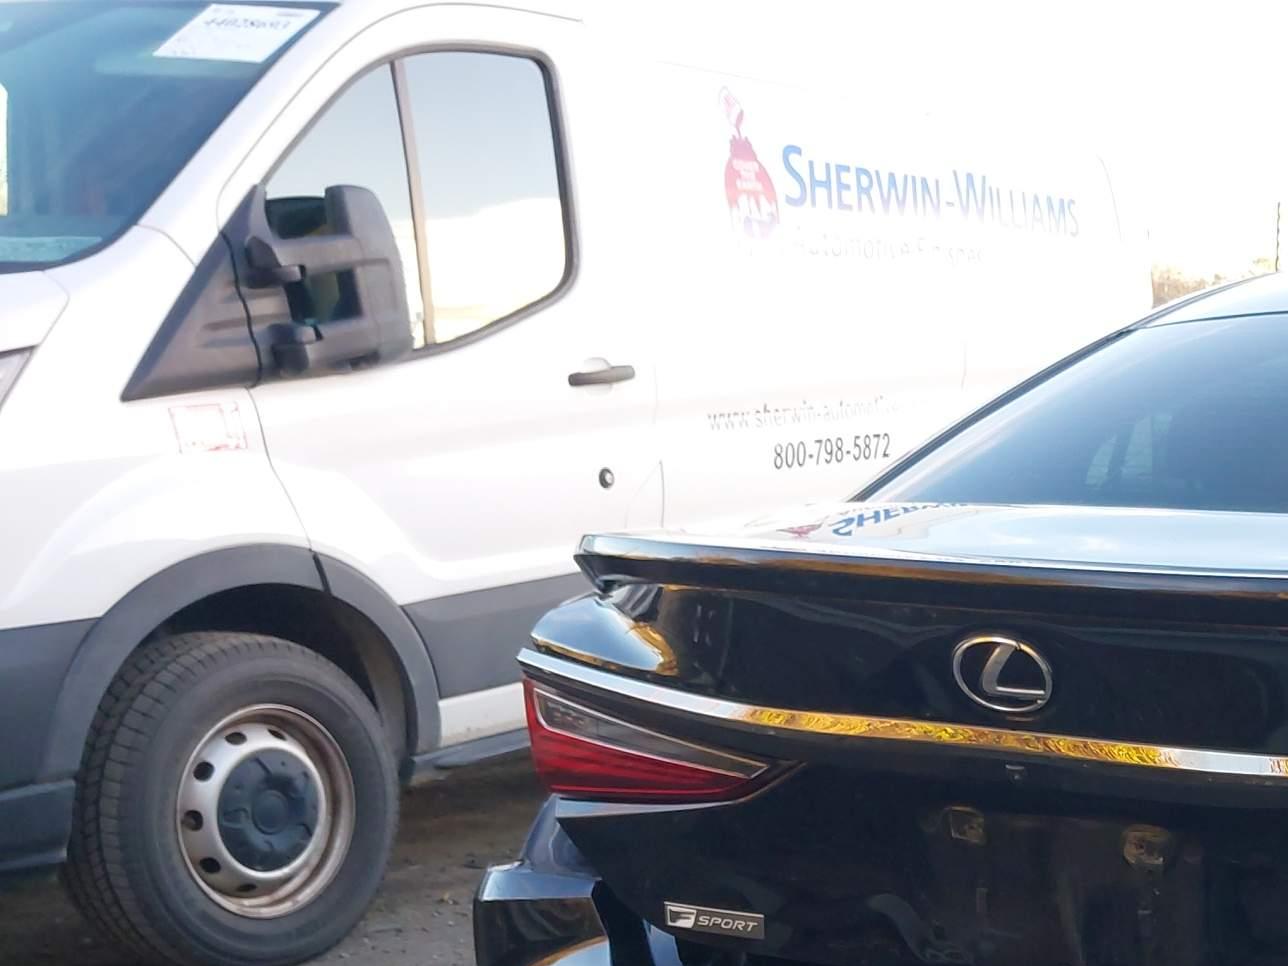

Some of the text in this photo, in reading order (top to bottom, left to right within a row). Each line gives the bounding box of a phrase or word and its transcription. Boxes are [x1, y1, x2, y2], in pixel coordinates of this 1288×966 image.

[782, 144, 1080, 238] SHERWIN-WILLIAMS
[772, 431, 892, 471] 800-798-5872
[697, 914, 759, 932] SPORT
